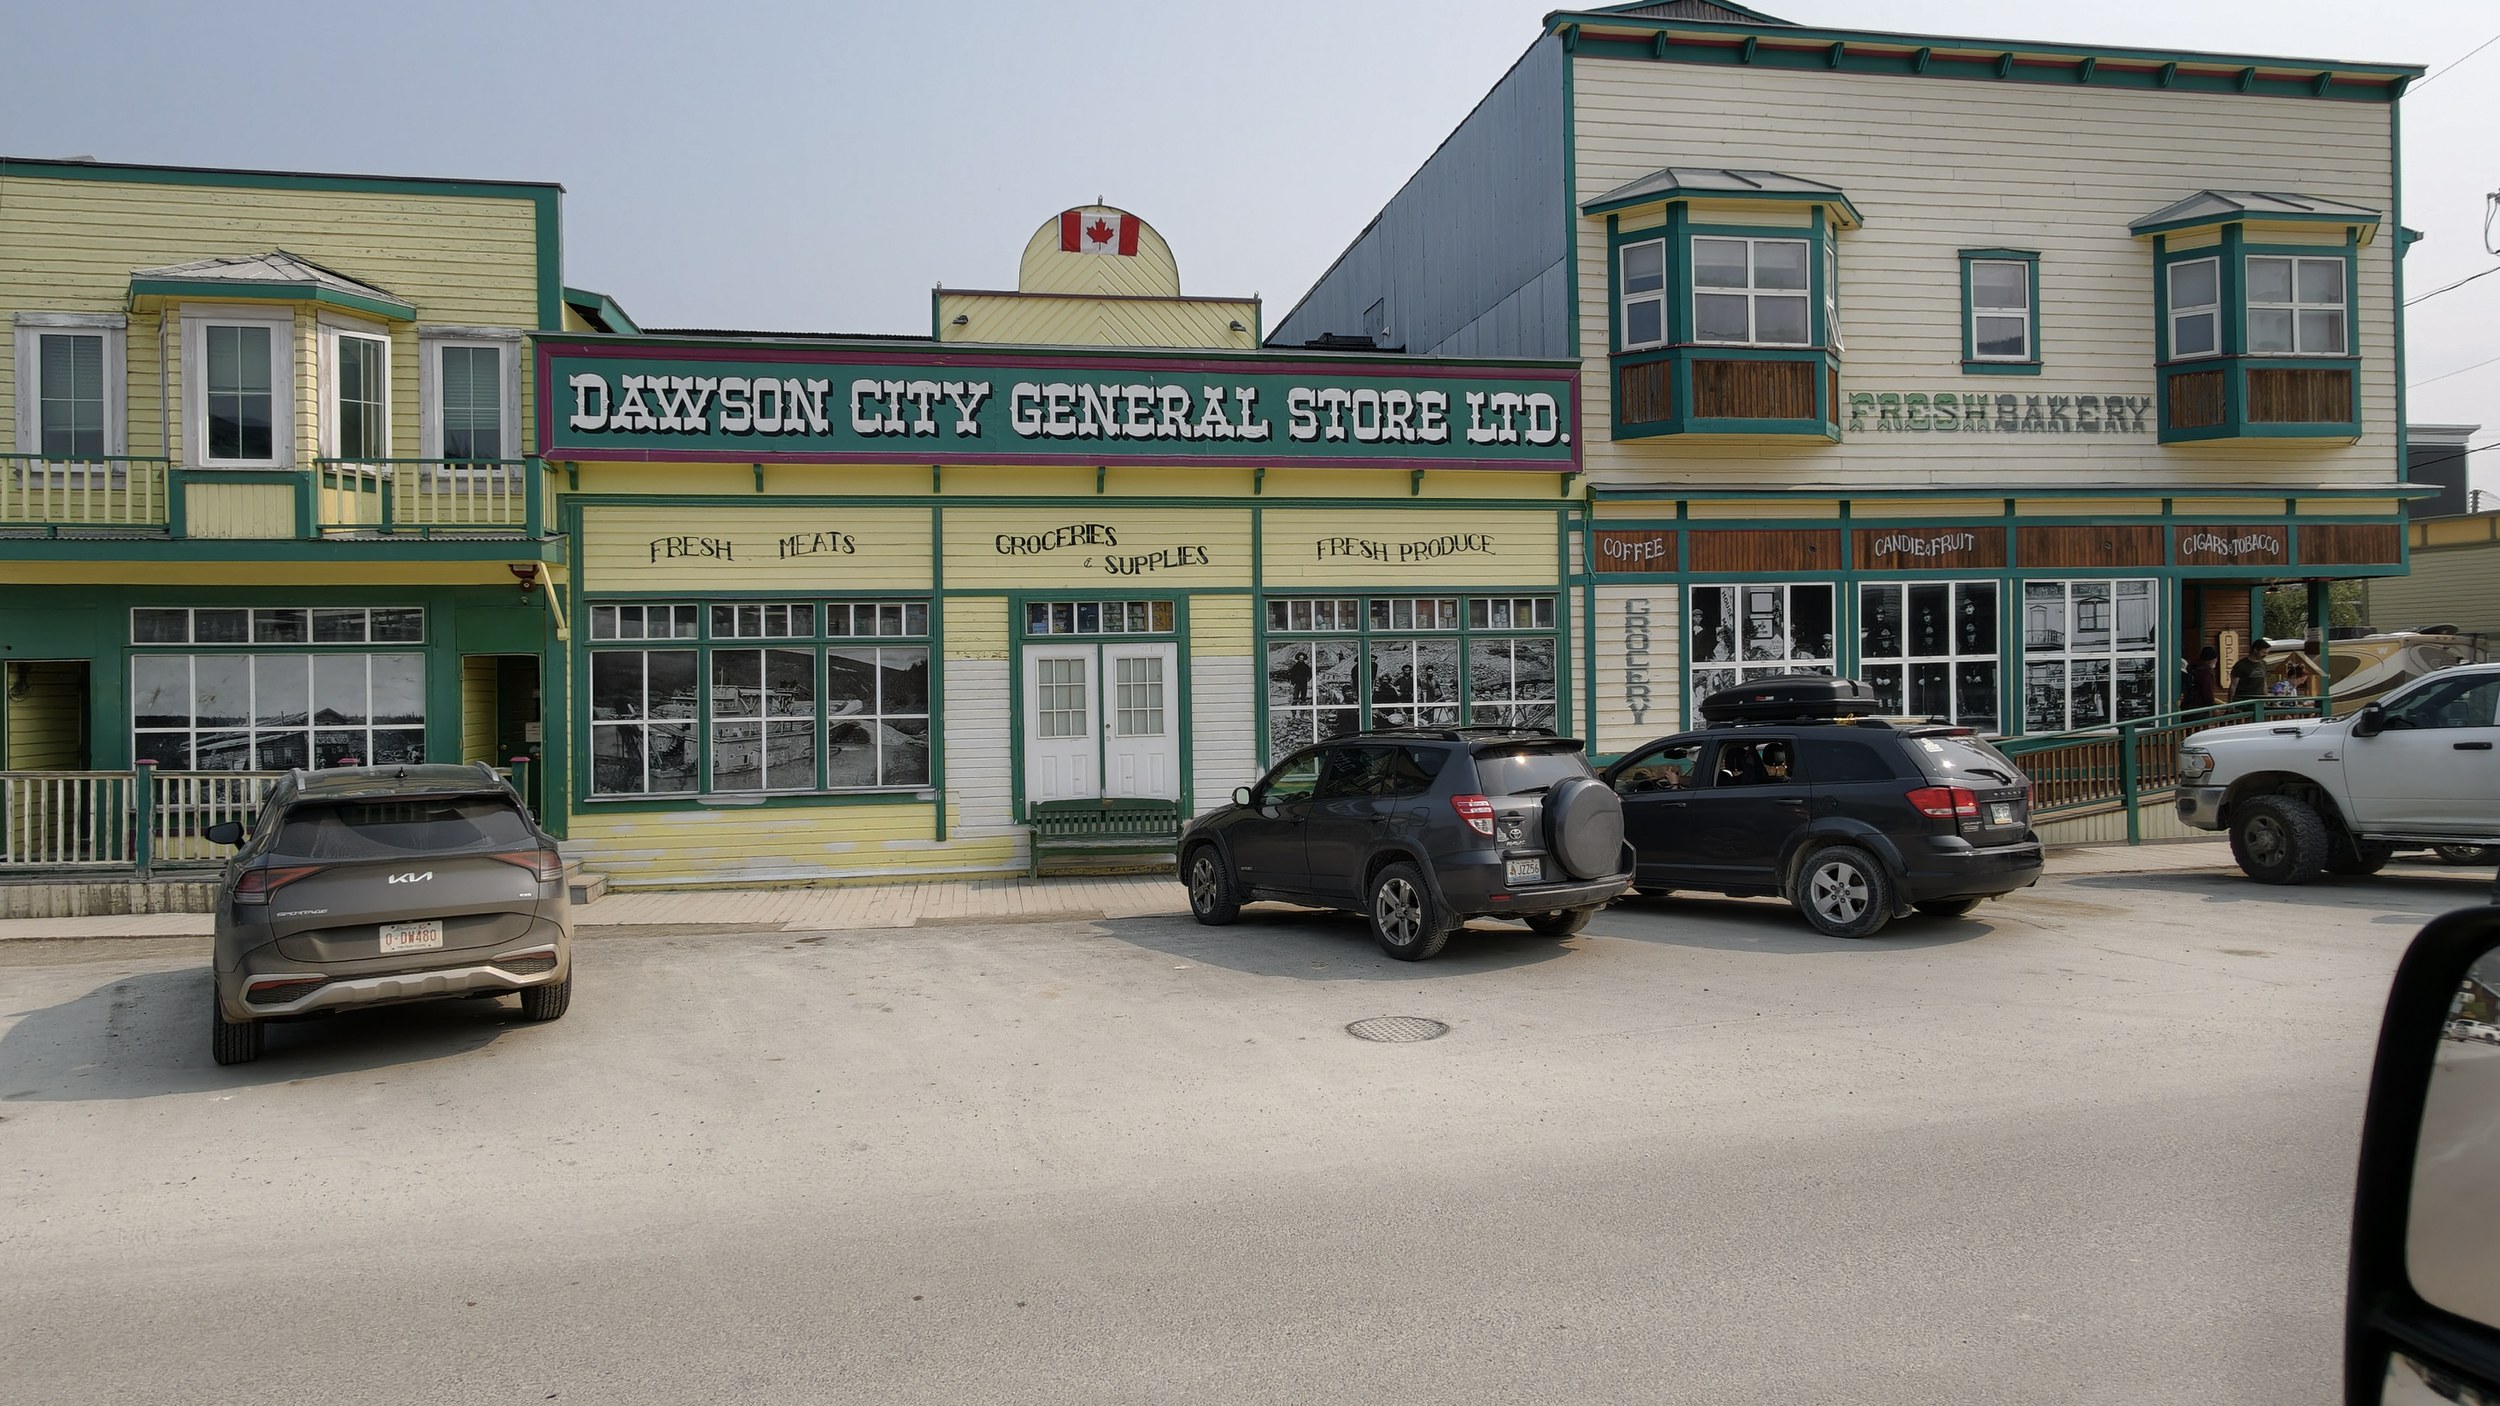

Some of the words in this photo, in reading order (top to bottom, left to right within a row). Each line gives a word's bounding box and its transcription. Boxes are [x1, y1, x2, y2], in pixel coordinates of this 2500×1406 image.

[569, 373, 832, 435] DAWSON
[850, 378, 993, 437] CITY
[1009, 381, 1271, 441] GENERAL
[1286, 387, 1449, 443] STORE
[1465, 391, 1571, 445] LTD.
[1849, 392, 1989, 433] FRESH
[1994, 393, 2150, 434] BAKERY
[650, 536, 734, 563] FRESH
[779, 531, 855, 560] MEATS
[995, 523, 1118, 555] GROCERIES
[1316, 537, 1389, 562] FRESH
[1399, 533, 1496, 562] PRODUCE
[1603, 537, 1666, 562] COFFEE
[1104, 545, 1209, 575] SUPPLIES
[1625, 598, 1651, 725] GROCERY
[388, 871, 433, 884] KIA
